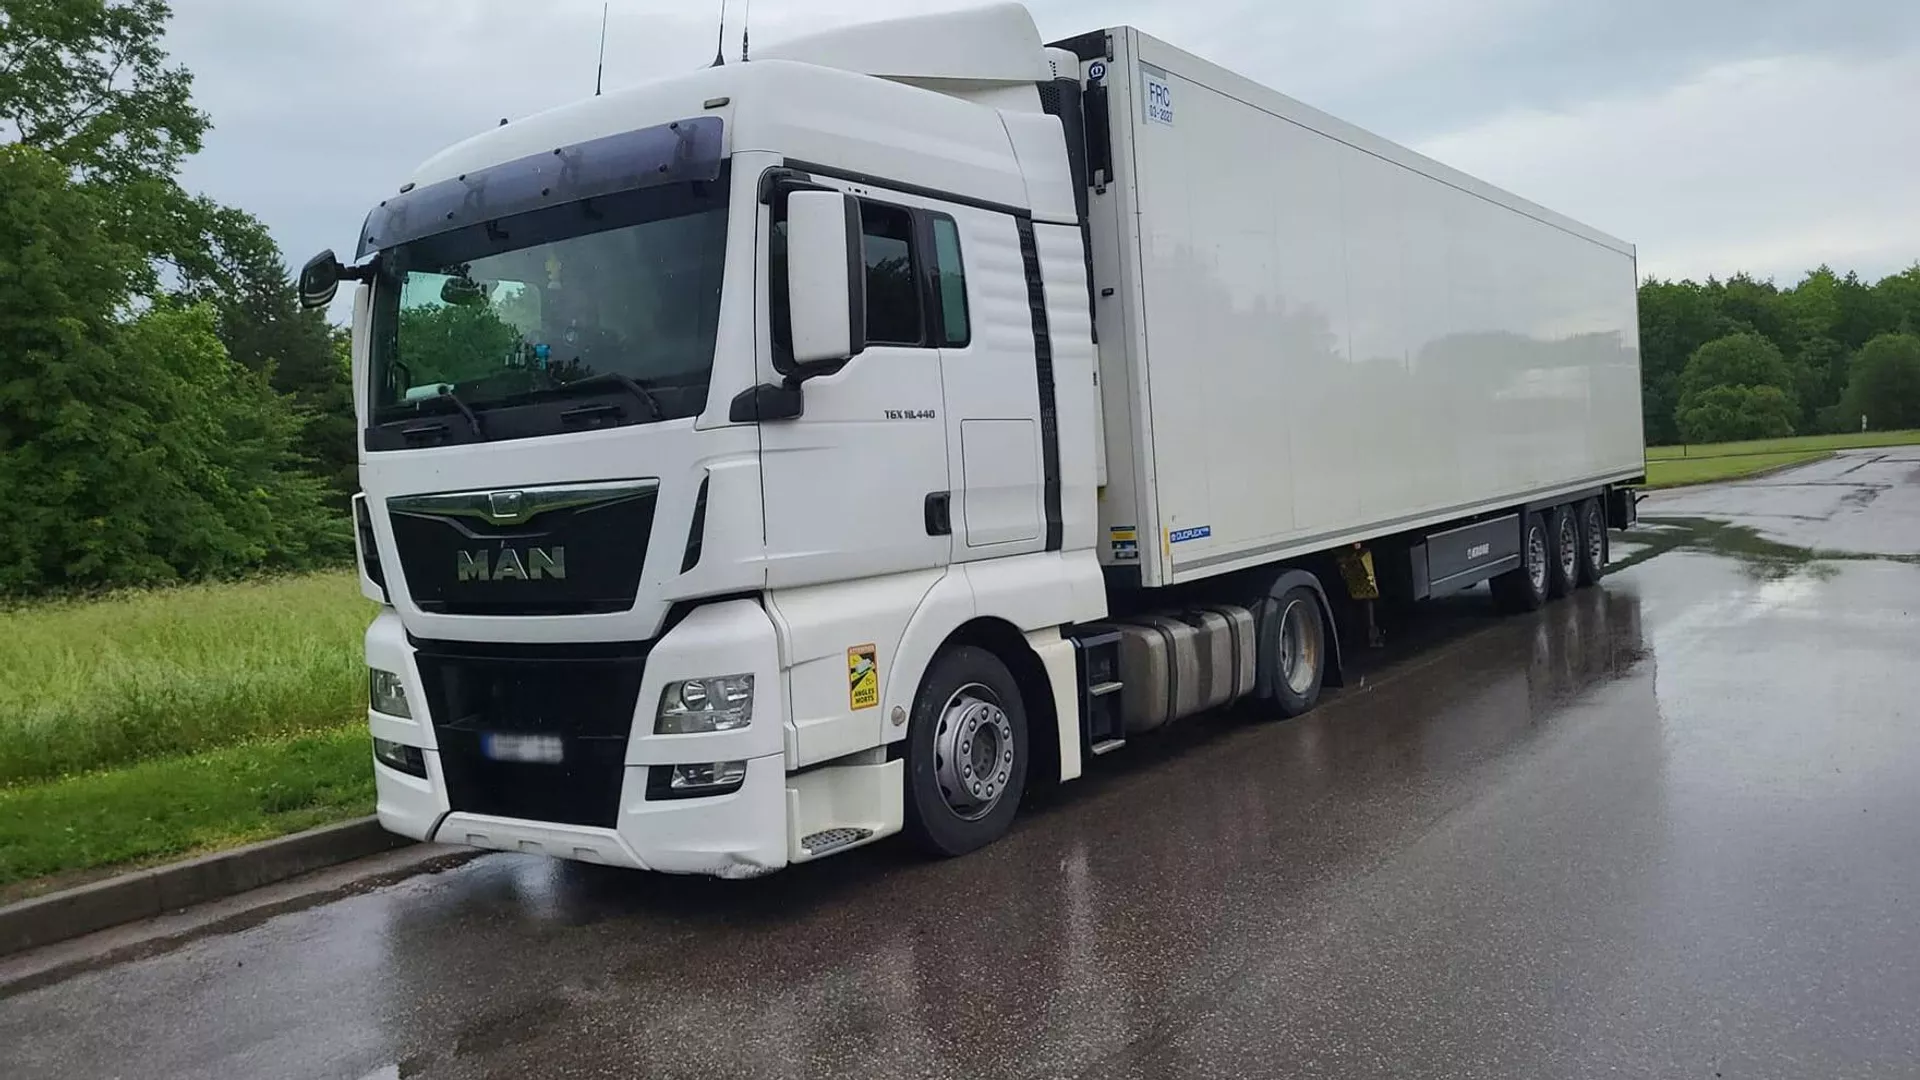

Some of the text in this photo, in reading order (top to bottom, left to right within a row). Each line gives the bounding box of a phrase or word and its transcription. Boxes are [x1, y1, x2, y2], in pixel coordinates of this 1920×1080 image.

[1150, 82, 1170, 107] FRC
[457, 546, 566, 581] MAN
[854, 688, 875, 697] ANGLES
